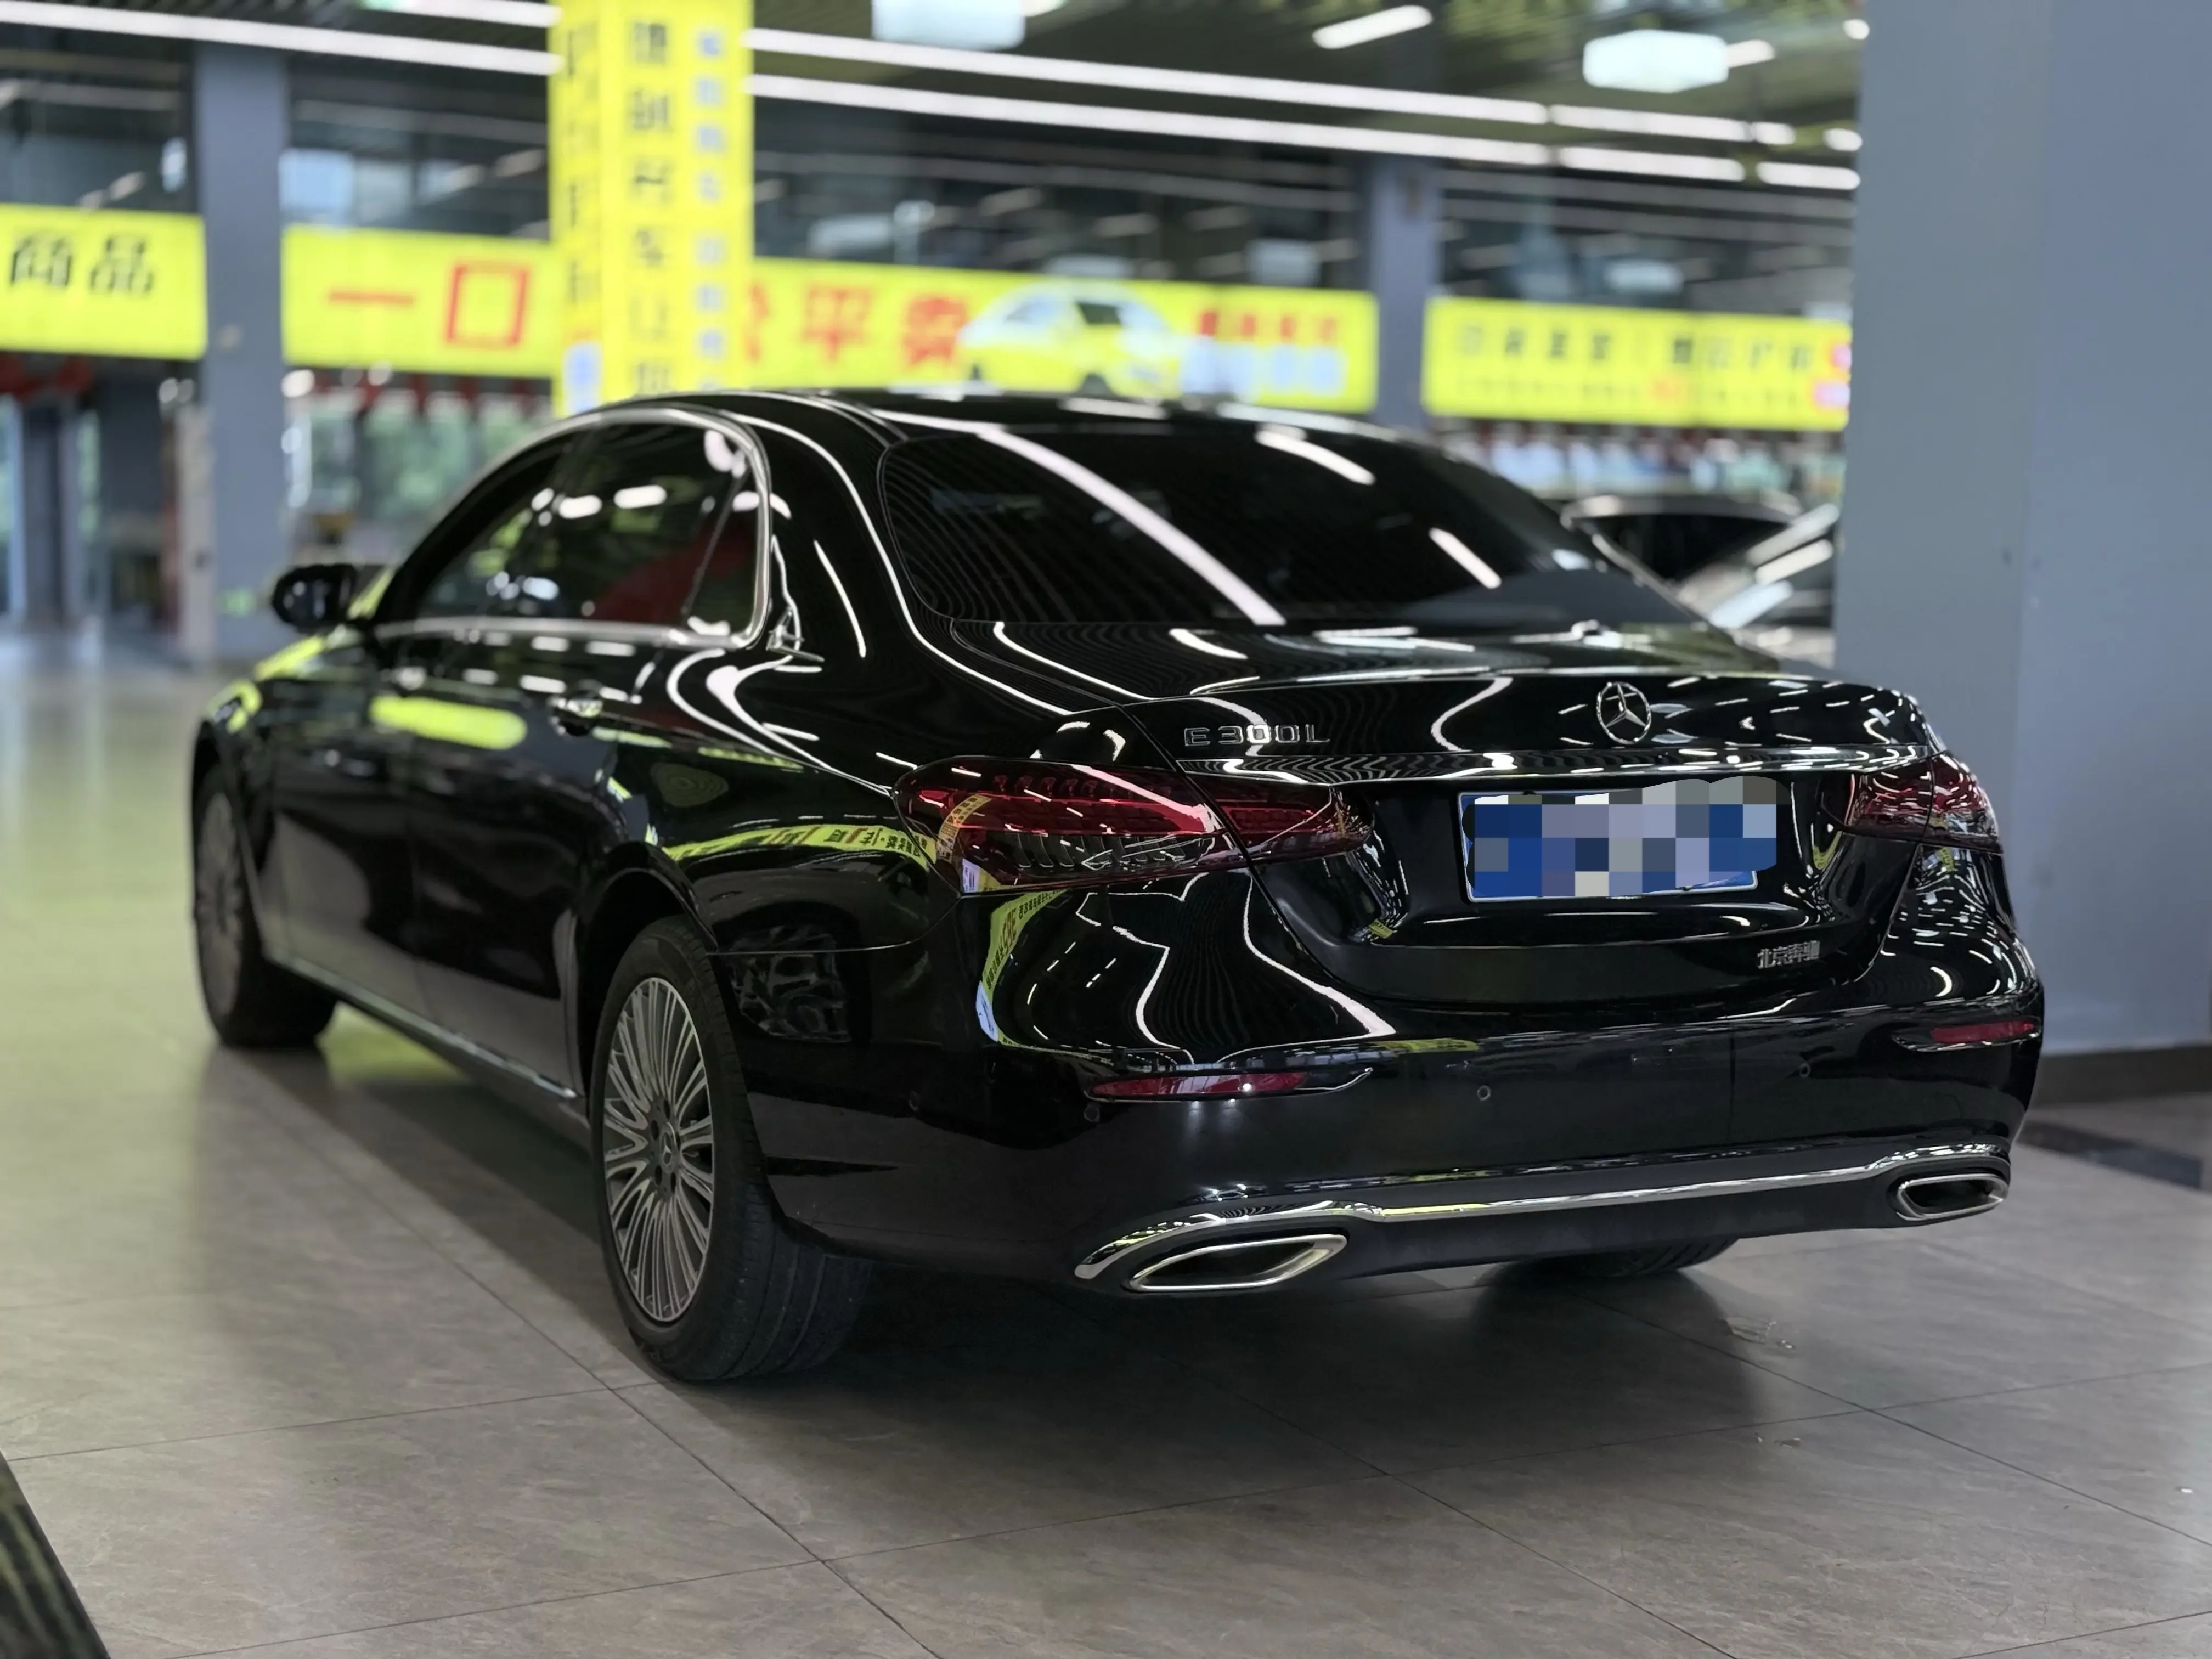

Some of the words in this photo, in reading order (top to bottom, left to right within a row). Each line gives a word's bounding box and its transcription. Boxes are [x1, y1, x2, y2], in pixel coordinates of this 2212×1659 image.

[10, 231, 154, 295] 商品
[1757, 940, 1820, 969] 北京奔驰
